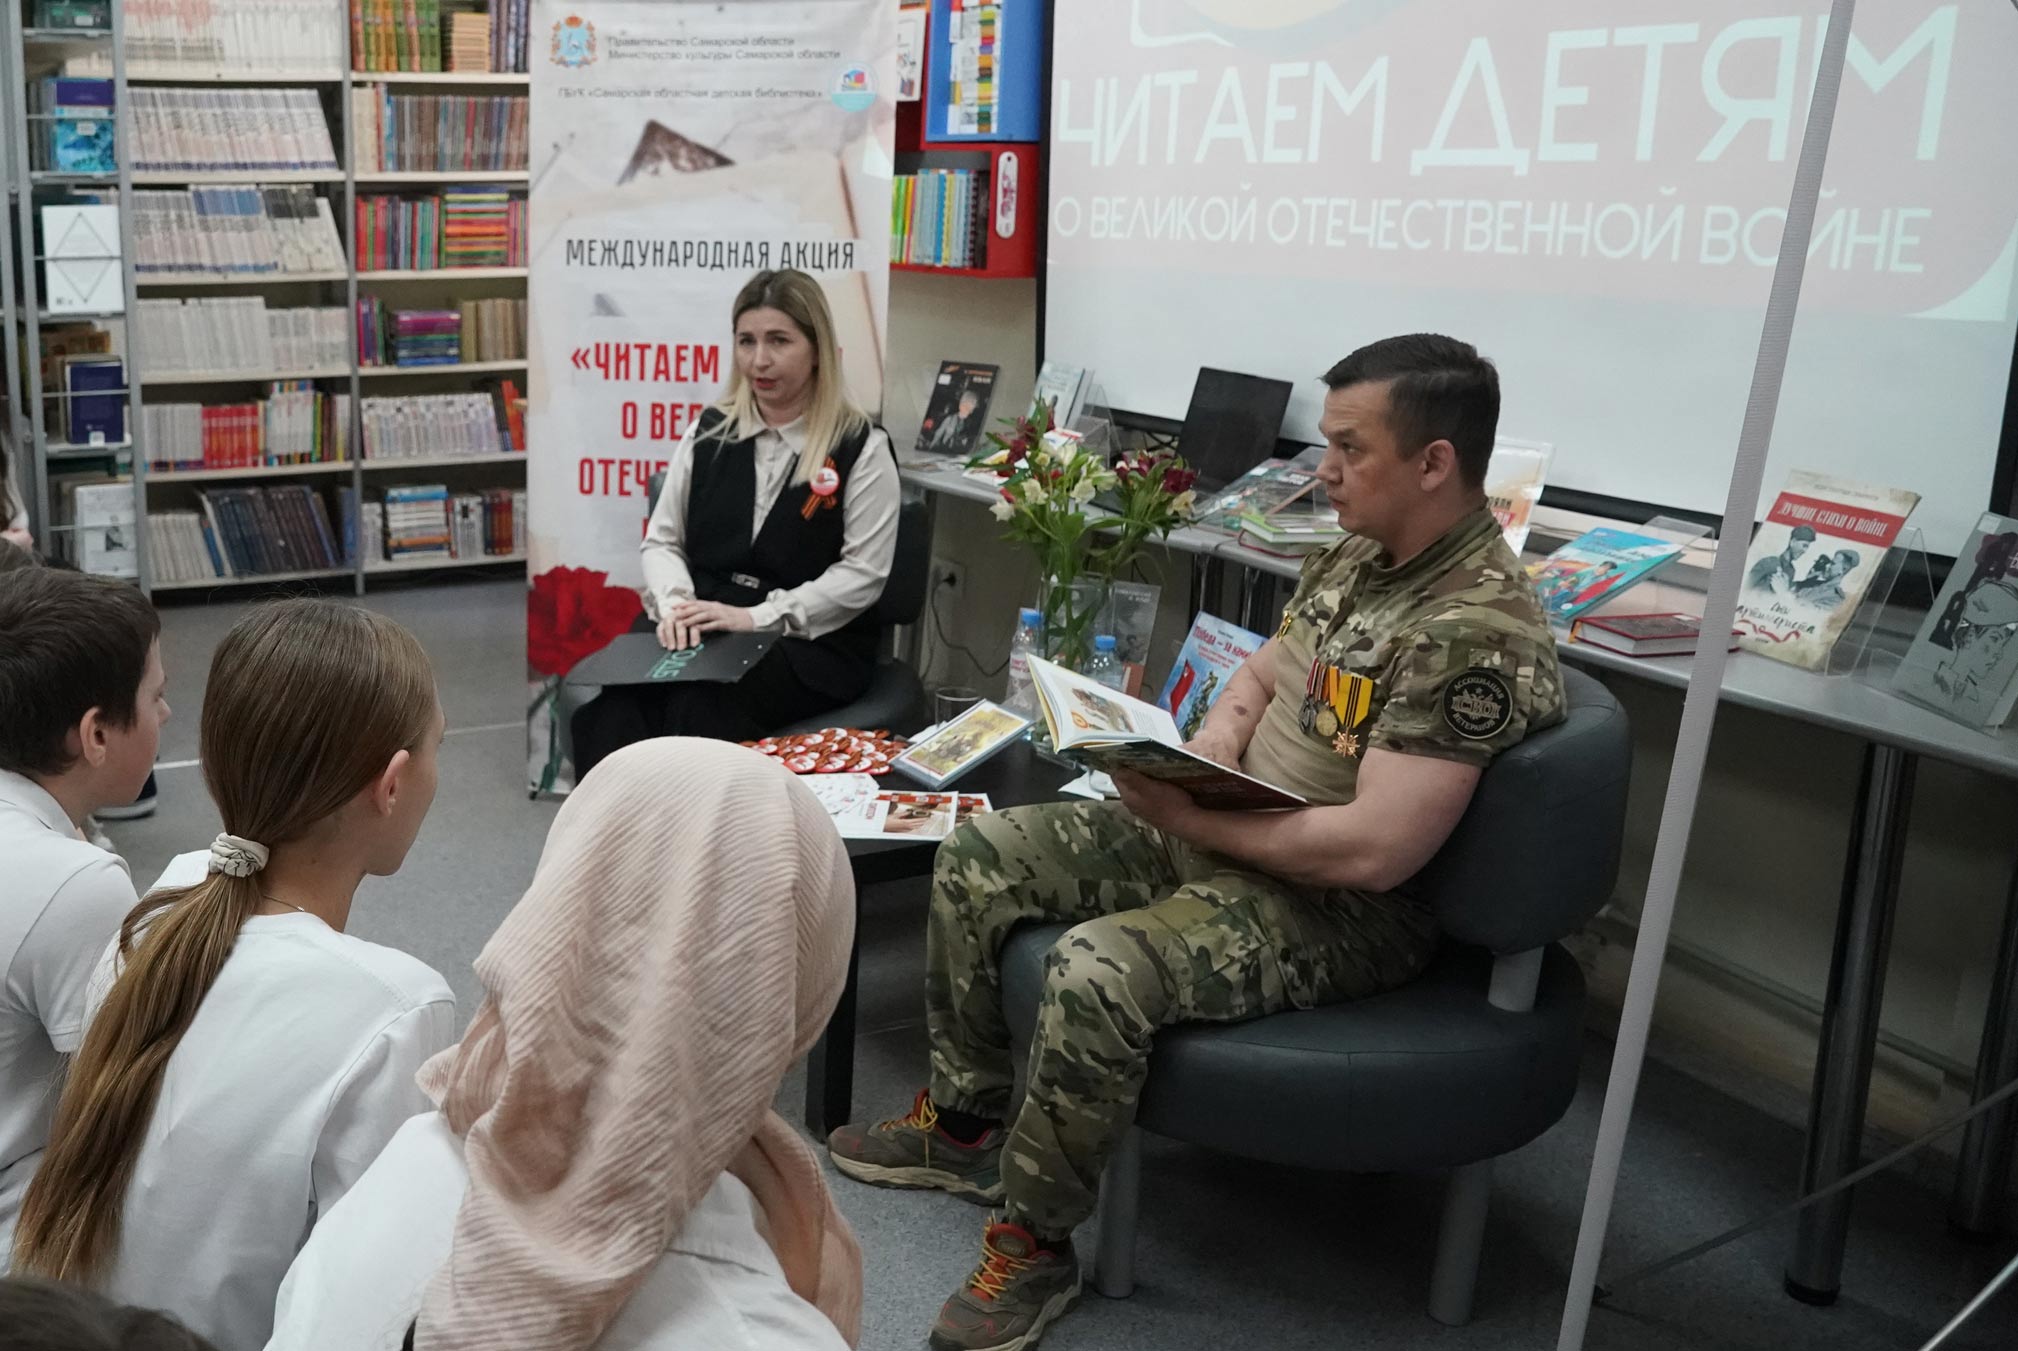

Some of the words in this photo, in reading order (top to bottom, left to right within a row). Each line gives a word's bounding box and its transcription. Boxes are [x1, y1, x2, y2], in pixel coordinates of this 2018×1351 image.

[1057, 56, 1389, 168] ЧИТАЕМ
[1409, 4, 1959, 176] ДЕТЯМ
[1053, 197, 1081, 237] О
[1089, 182, 1257, 243] ВЕЛИКОЙ
[1266, 185, 1686, 263] ОТЕЧЕСТВЕННОЙ
[1699, 187, 1933, 273] ВОЙНЕ
[565, 238, 770, 270] МЕЖДУНАРОДНАЯ
[779, 241, 855, 272] АКЦИЯ
[571, 342, 720, 384] «ЧИТАЕМ
[621, 401, 638, 440] О
